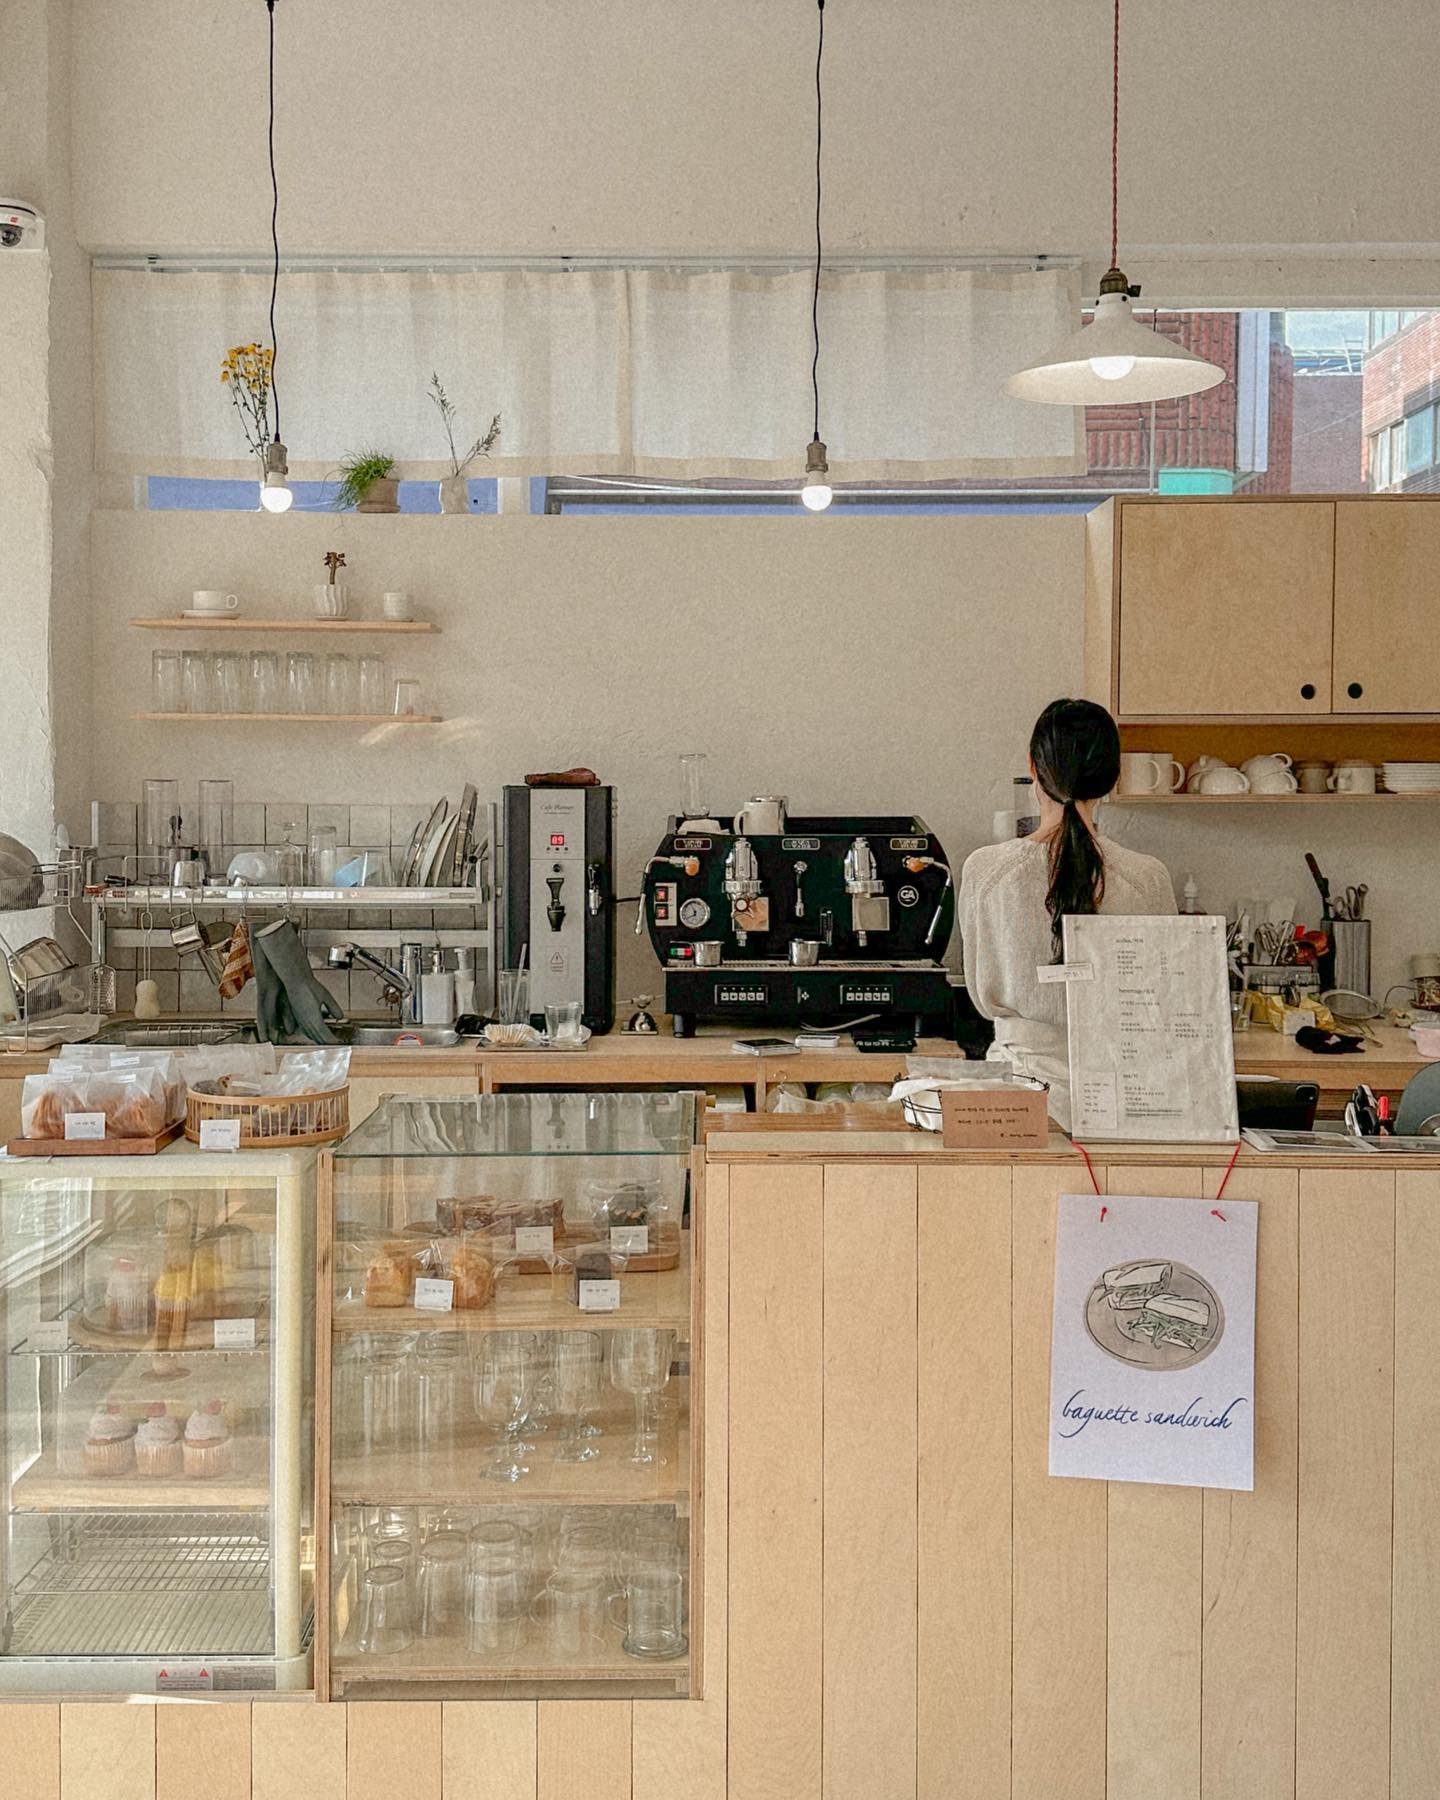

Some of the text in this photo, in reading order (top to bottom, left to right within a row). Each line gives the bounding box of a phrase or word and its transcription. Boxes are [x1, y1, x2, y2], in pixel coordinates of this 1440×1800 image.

[551, 835, 564, 845] 89
[1058, 1389, 1248, 1438] baguette sandwich
